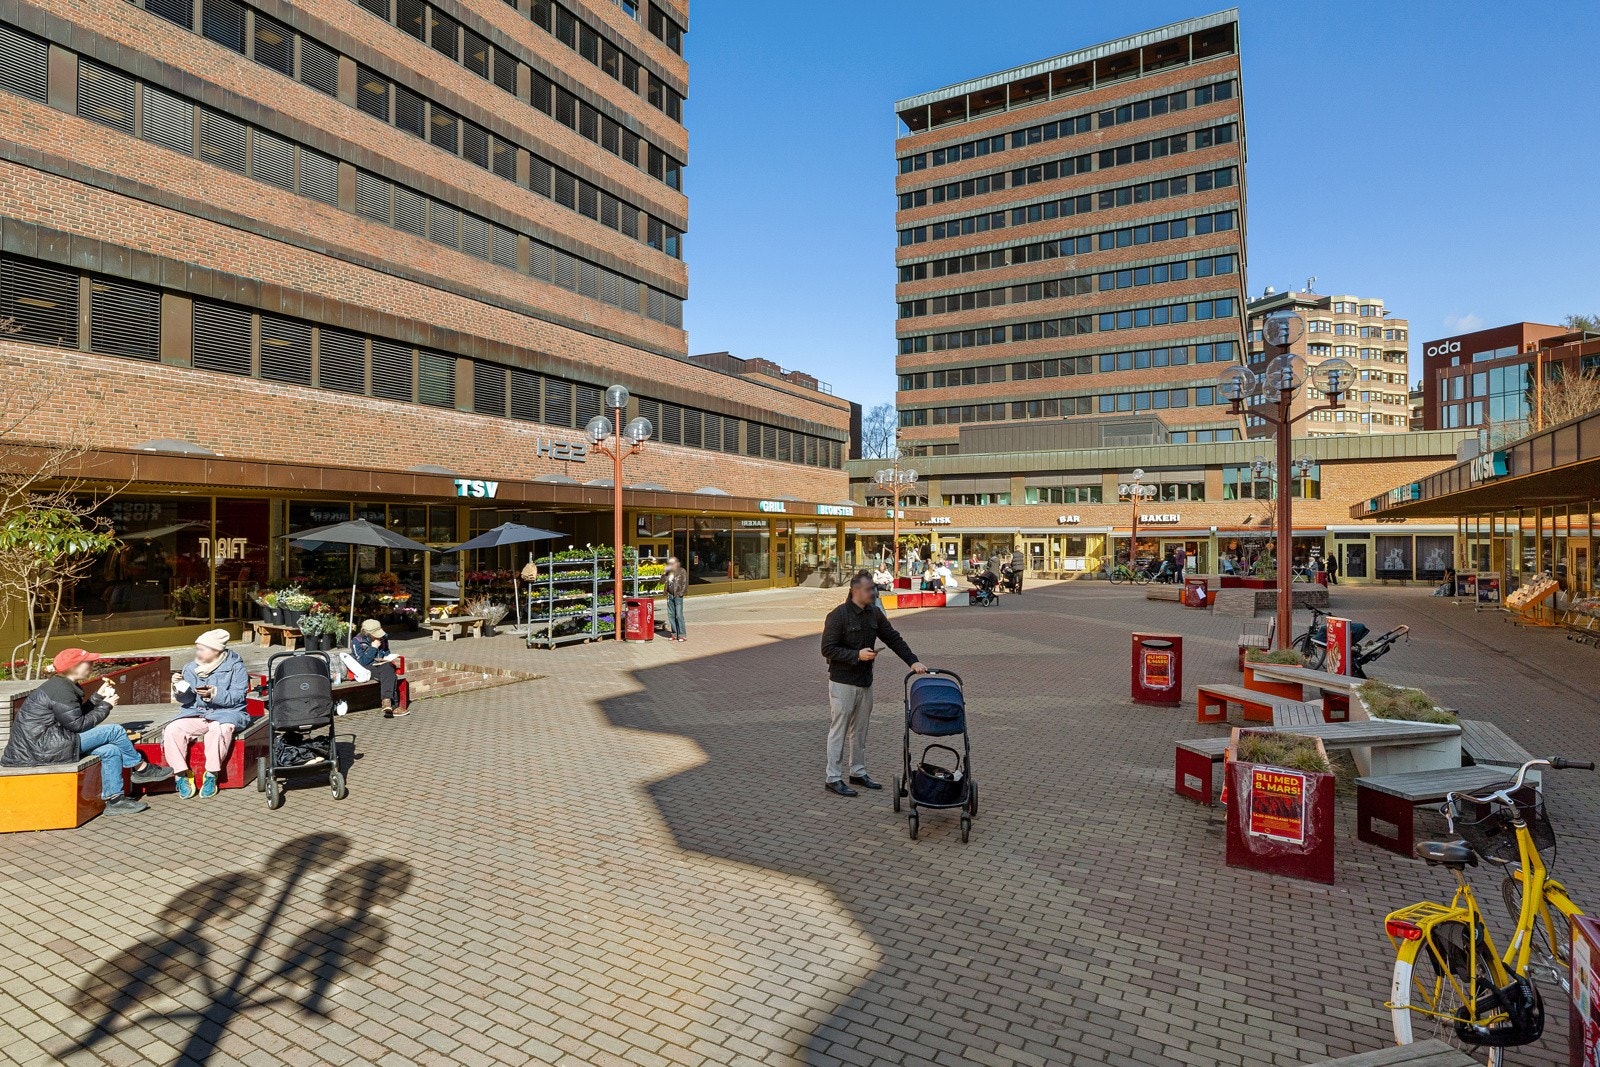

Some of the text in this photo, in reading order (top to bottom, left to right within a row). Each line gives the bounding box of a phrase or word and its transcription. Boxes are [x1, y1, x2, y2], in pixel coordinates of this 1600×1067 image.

[1427, 341, 1461, 357] oda
[537, 438, 586, 463] H22
[1470, 451, 1501, 482] KIOSK
[456, 478, 499, 499] TSV
[761, 500, 786, 513] GRILL
[818, 504, 854, 517] BLOMSTER
[1059, 515, 1080, 524] BAR
[1140, 514, 1180, 523] BAKERI
[1256, 773, 1299, 786] BLI MED
[1255, 782, 1265, 790] 8.
[1267, 783, 1301, 795] MARS!
